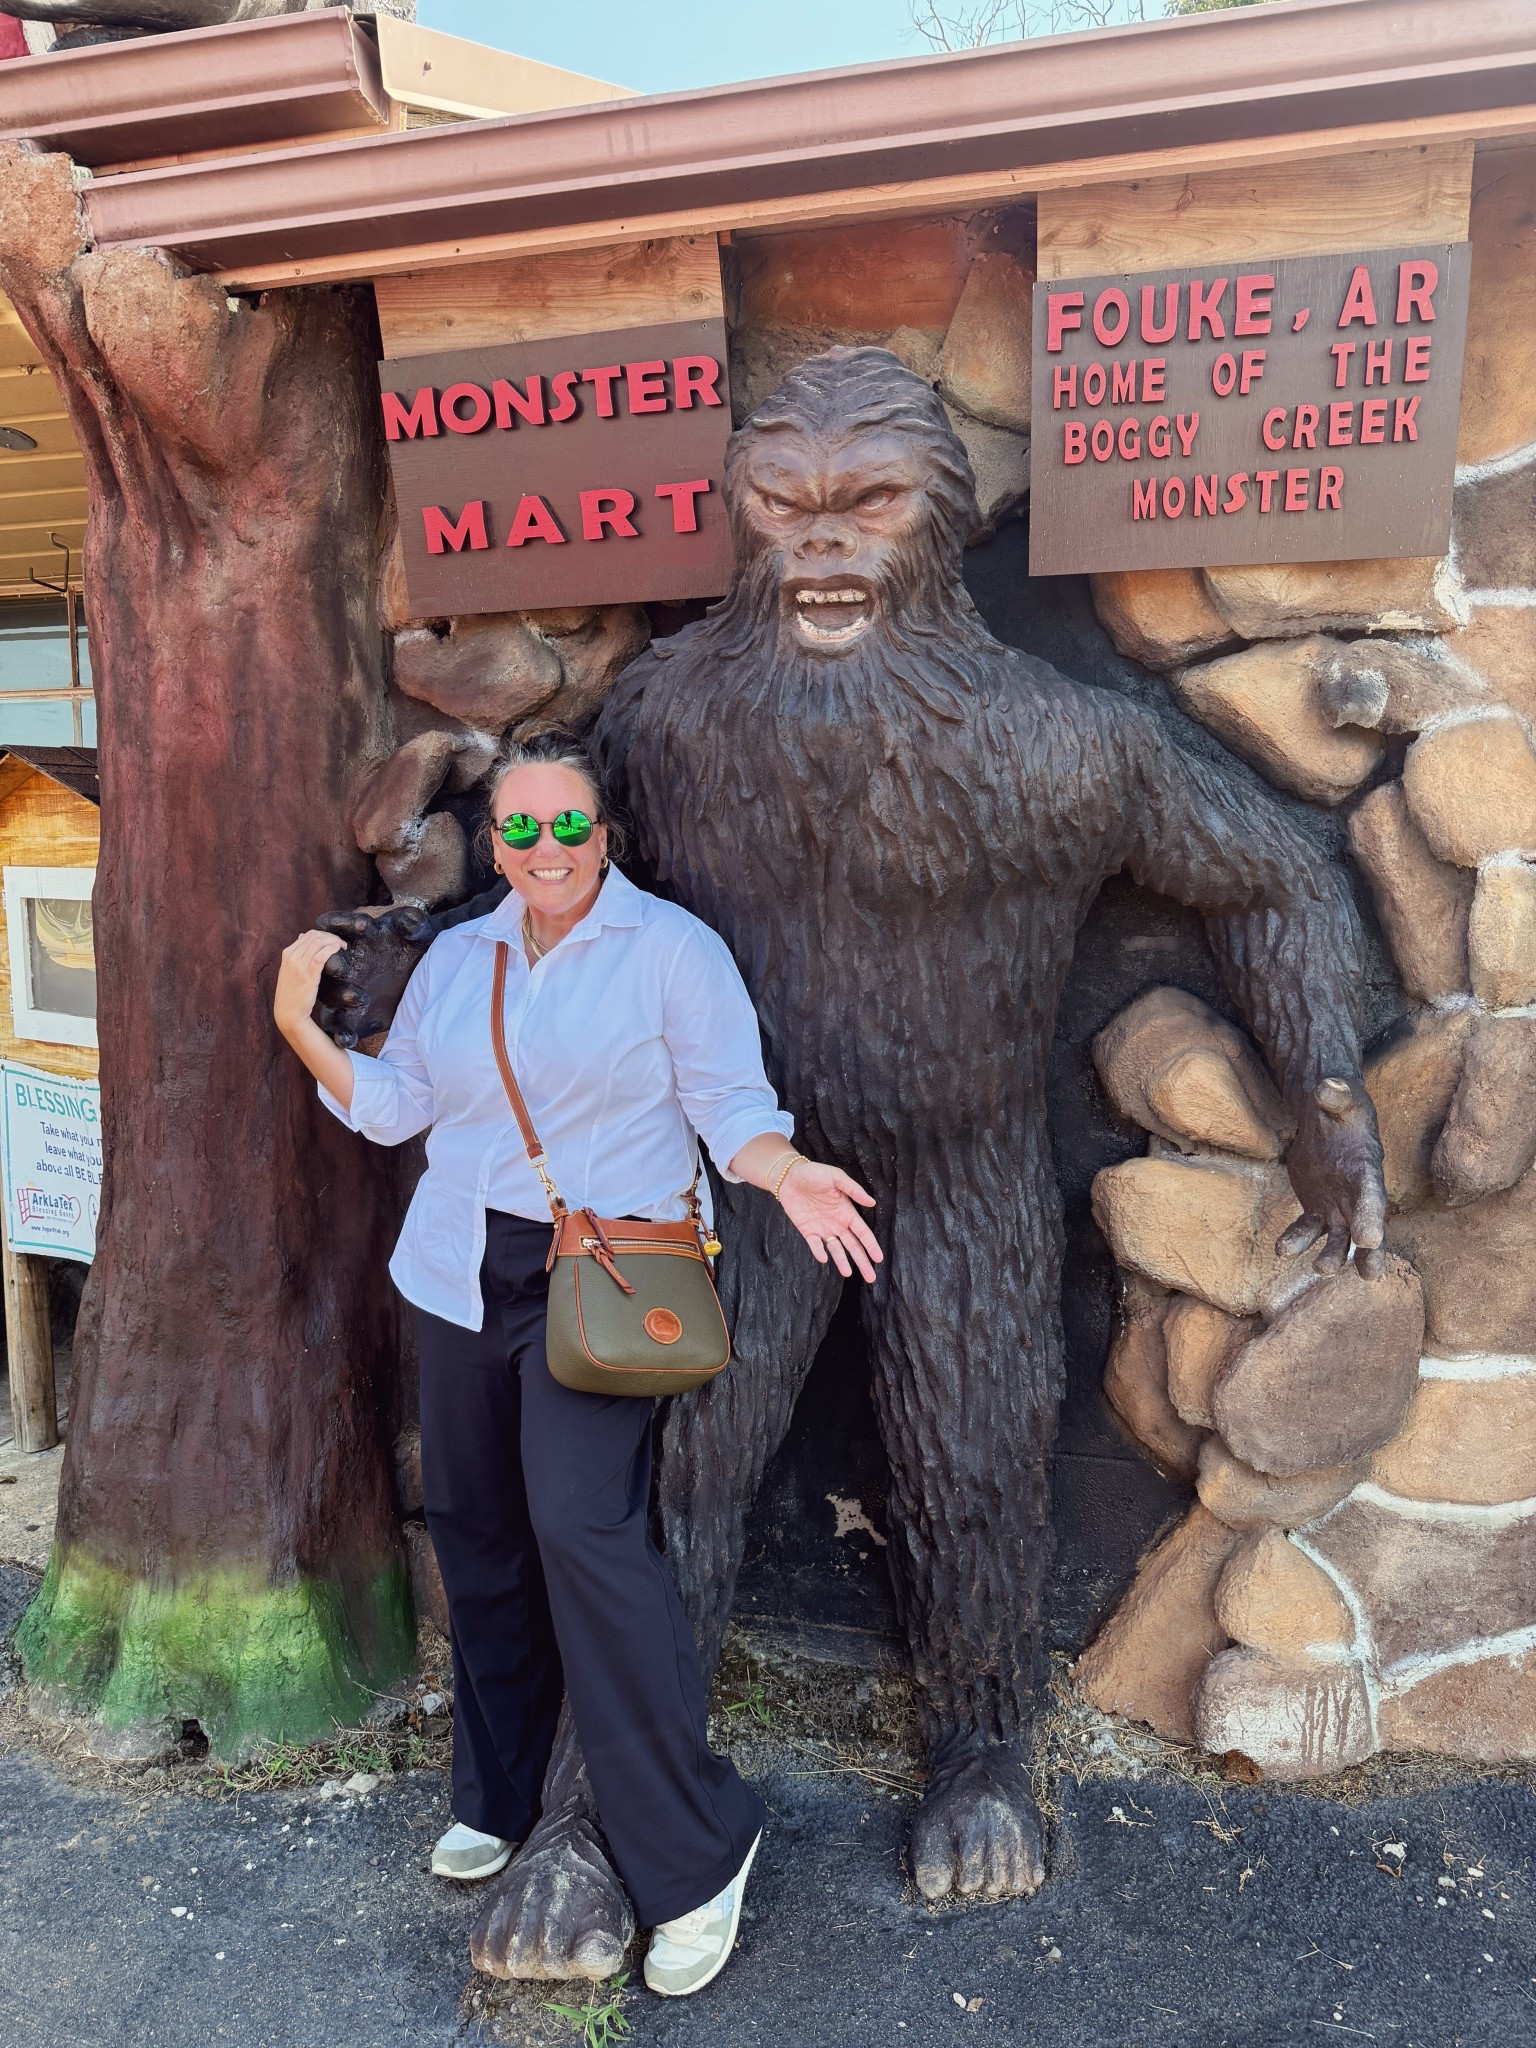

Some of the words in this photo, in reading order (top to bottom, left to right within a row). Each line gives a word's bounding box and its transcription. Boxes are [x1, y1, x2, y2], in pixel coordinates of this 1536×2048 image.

[1338, 259, 1439, 328] AR
[381, 355, 723, 441] MONSTER
[1053, 357, 1167, 409] HOME
[1212, 349, 1266, 397] OF
[1330, 336, 1432, 388] THE
[1064, 412, 1200, 464] BOGGY
[1262, 396, 1421, 451] CREEK
[421, 479, 711, 555] MART
[1132, 466, 1345, 521] MONSTER
[15, 1082, 98, 1122] BLESSING
[40, 1121, 60, 1137] Take
[60, 1127, 79, 1142] what
[79, 1134, 94, 1146] you
[44, 1140, 67, 1157] leave
[67, 1147, 85, 1163] what
[85, 1154, 103, 1167] you
[36, 1159, 63, 1174] above
[64, 1165, 74, 1177] all
[75, 1166, 87, 1180] BE
[32, 1192, 73, 1211] ArkLaTex
